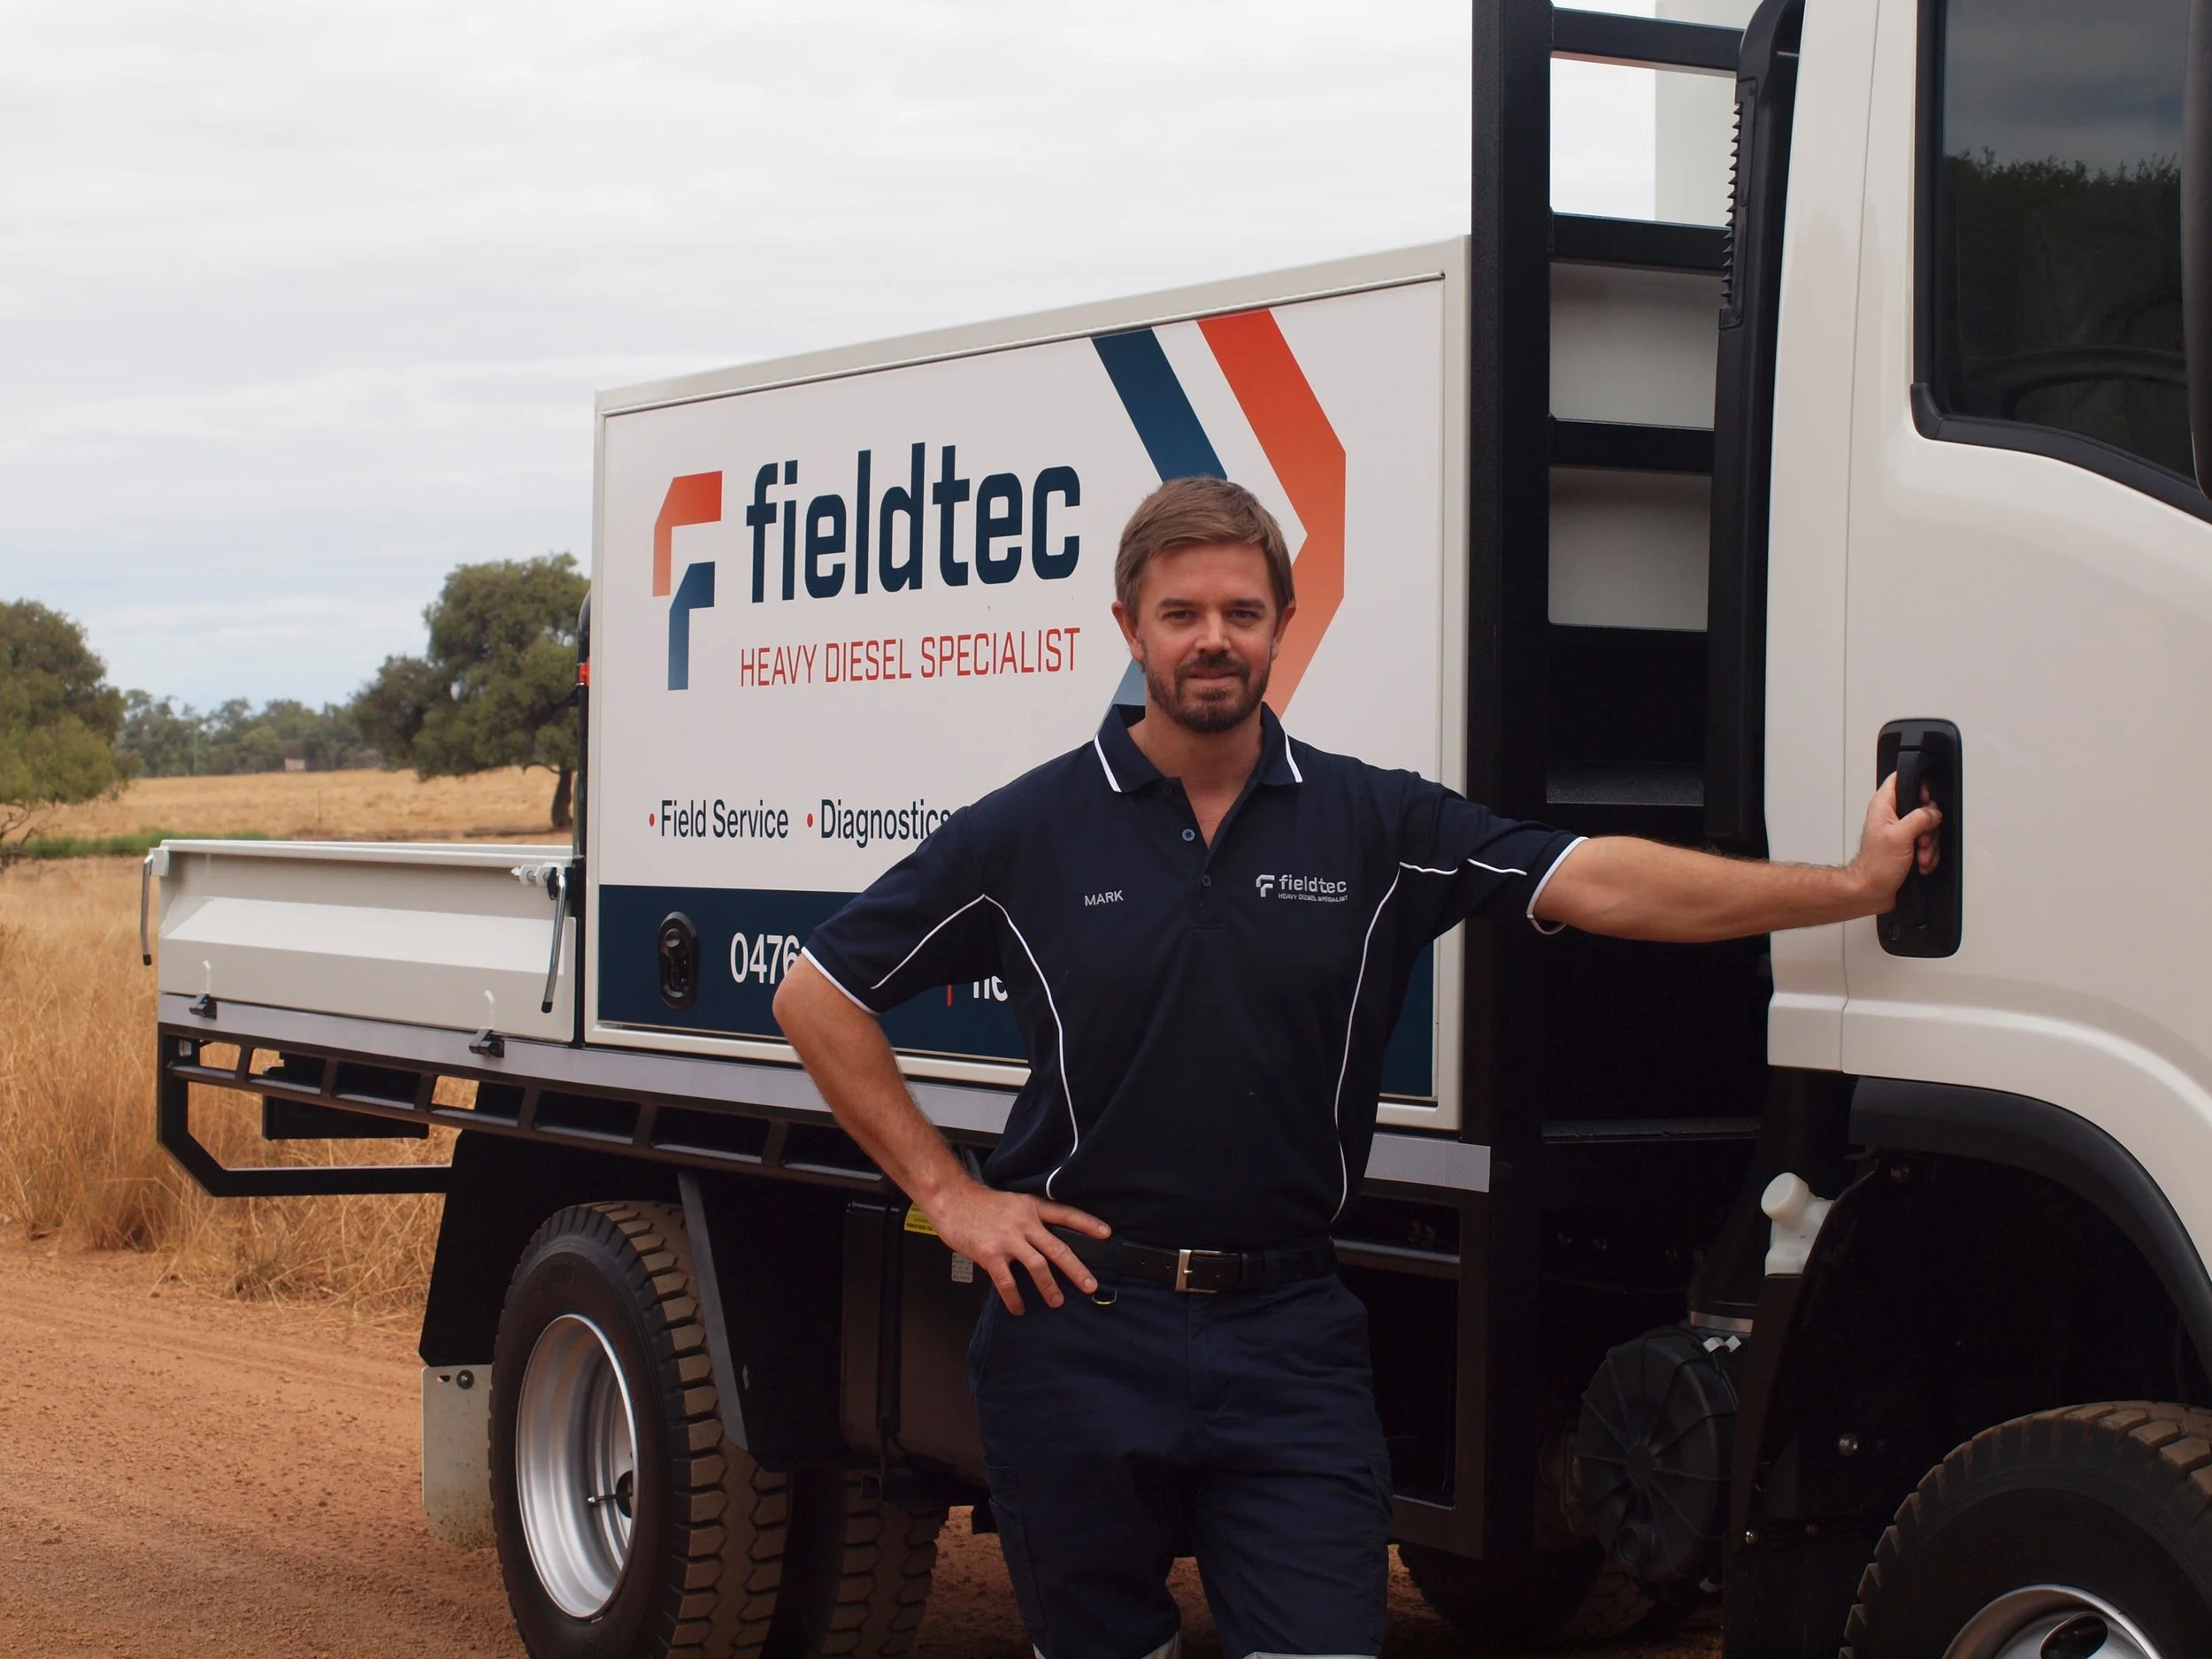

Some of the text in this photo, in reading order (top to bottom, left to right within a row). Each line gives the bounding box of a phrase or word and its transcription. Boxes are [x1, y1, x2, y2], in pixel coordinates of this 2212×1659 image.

[745, 442, 1081, 604] fieldtec
[741, 627, 1081, 687] HEAVY DIESEL SPECIALIST
[661, 799, 707, 838] Field
[712, 798, 789, 839] Service
[1084, 890, 1124, 907] MARK
[1279, 874, 1348, 895] fieldtec
[730, 932, 800, 985] 0476
